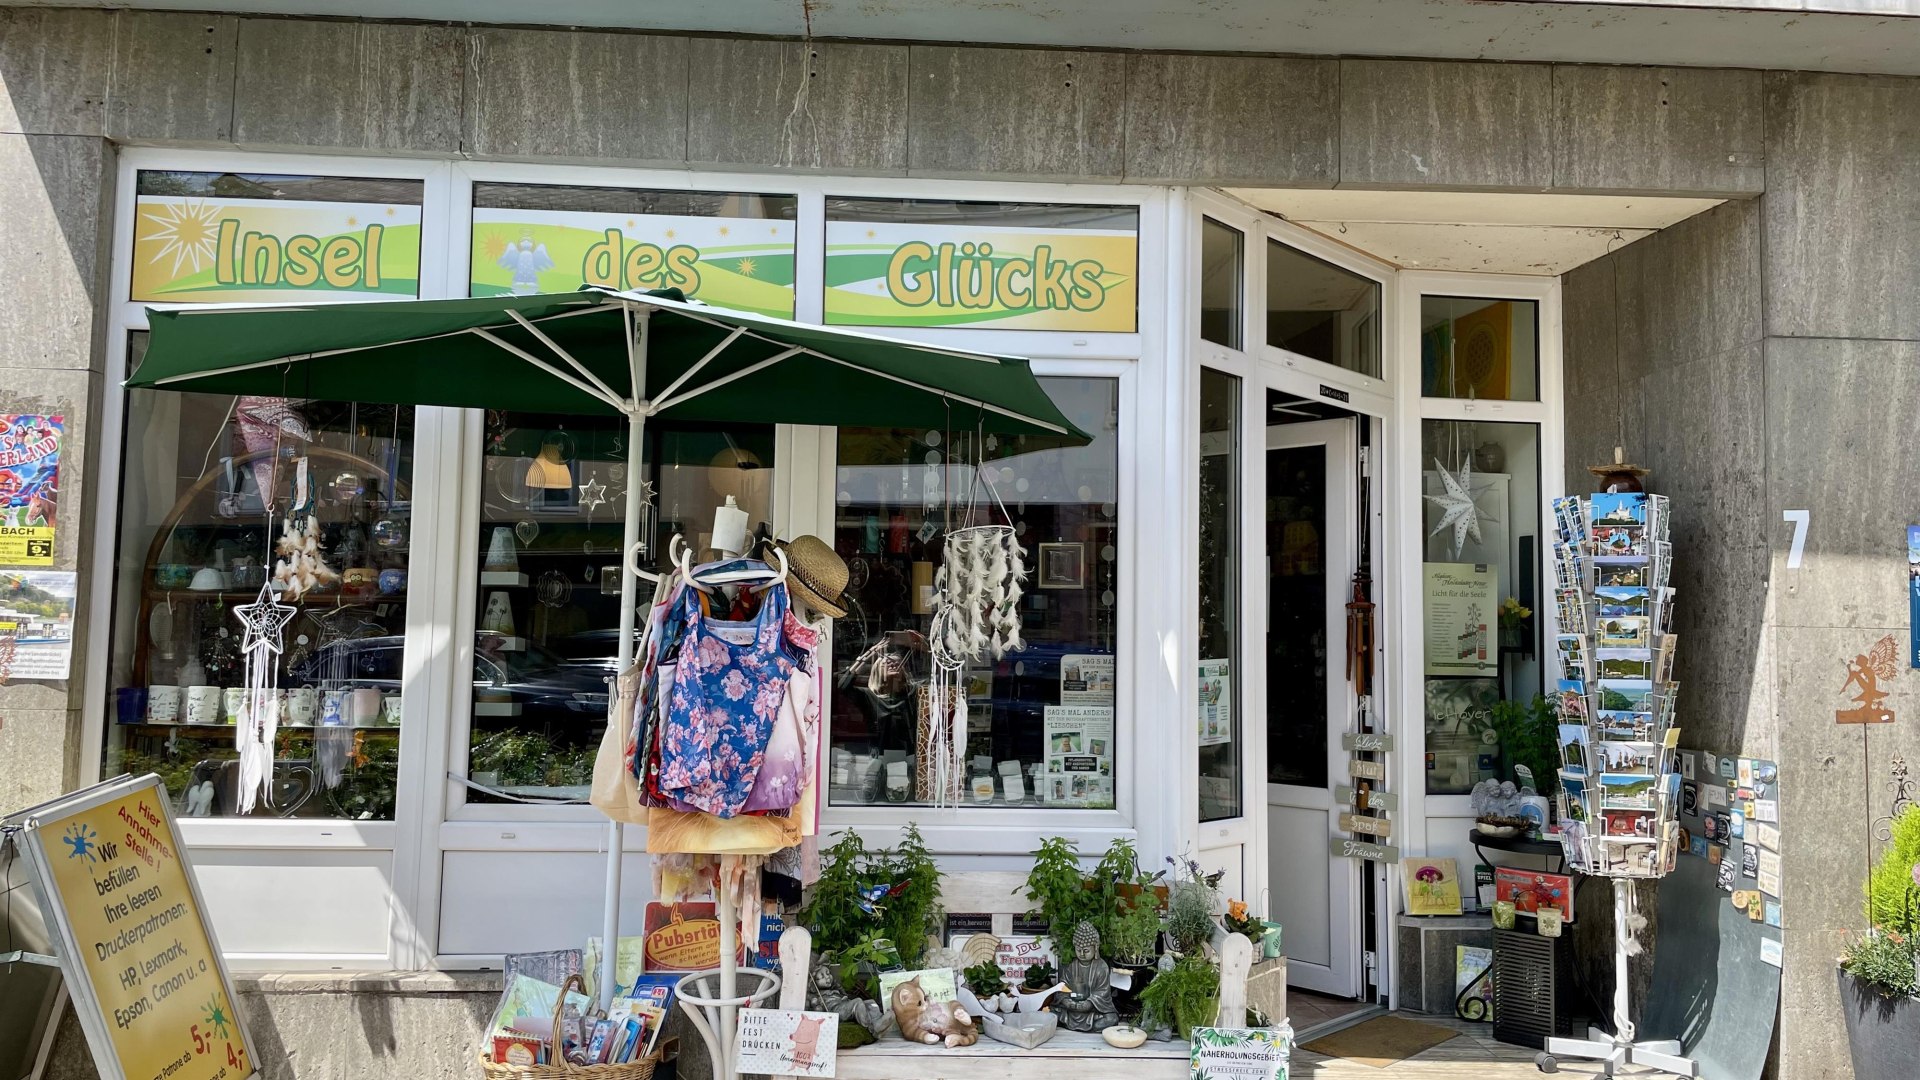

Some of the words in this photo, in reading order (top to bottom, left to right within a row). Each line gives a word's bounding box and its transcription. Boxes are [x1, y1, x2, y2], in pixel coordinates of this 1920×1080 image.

[215, 218, 384, 289] Insel
[582, 228, 701, 296] des
[886, 240, 1105, 312] Glücks
[1783, 510, 1809, 568] 7
[1449, 590, 1458, 598] für
[1460, 590, 1469, 598] die
[1471, 590, 1487, 598] Seele
[139, 800, 161, 828] Hier
[118, 805, 173, 858] Annahme-
[98, 842, 118, 863] Wir
[125, 833, 154, 867] Stelle
[1343, 840, 1383, 859] Träume
[94, 865, 140, 896] befüllen
[104, 903, 129, 924] Ihre
[127, 885, 162, 912] leeren
[95, 903, 188, 961] Druckerpatronen:
[658, 953, 677, 961] wenn
[680, 945, 703, 956] Eltern
[679, 949, 718, 964] schwierig
[1017, 942, 1041, 956] Du
[119, 967, 142, 991] HP,
[139, 938, 188, 978] Lexmark,
[1000, 954, 1048, 966] Freund
[114, 996, 153, 1030] Epson,
[152, 972, 186, 1003] Canon
[186, 966, 198, 981] u.
[744, 1016, 767, 1024] BITTE
[743, 1028, 763, 1036] FEST
[742, 1040, 781, 1049] DRÜCKEN
[183, 1050, 192, 1063] ab
[1200, 1050, 1280, 1061] NAHERHOLUNGSGEBIET
